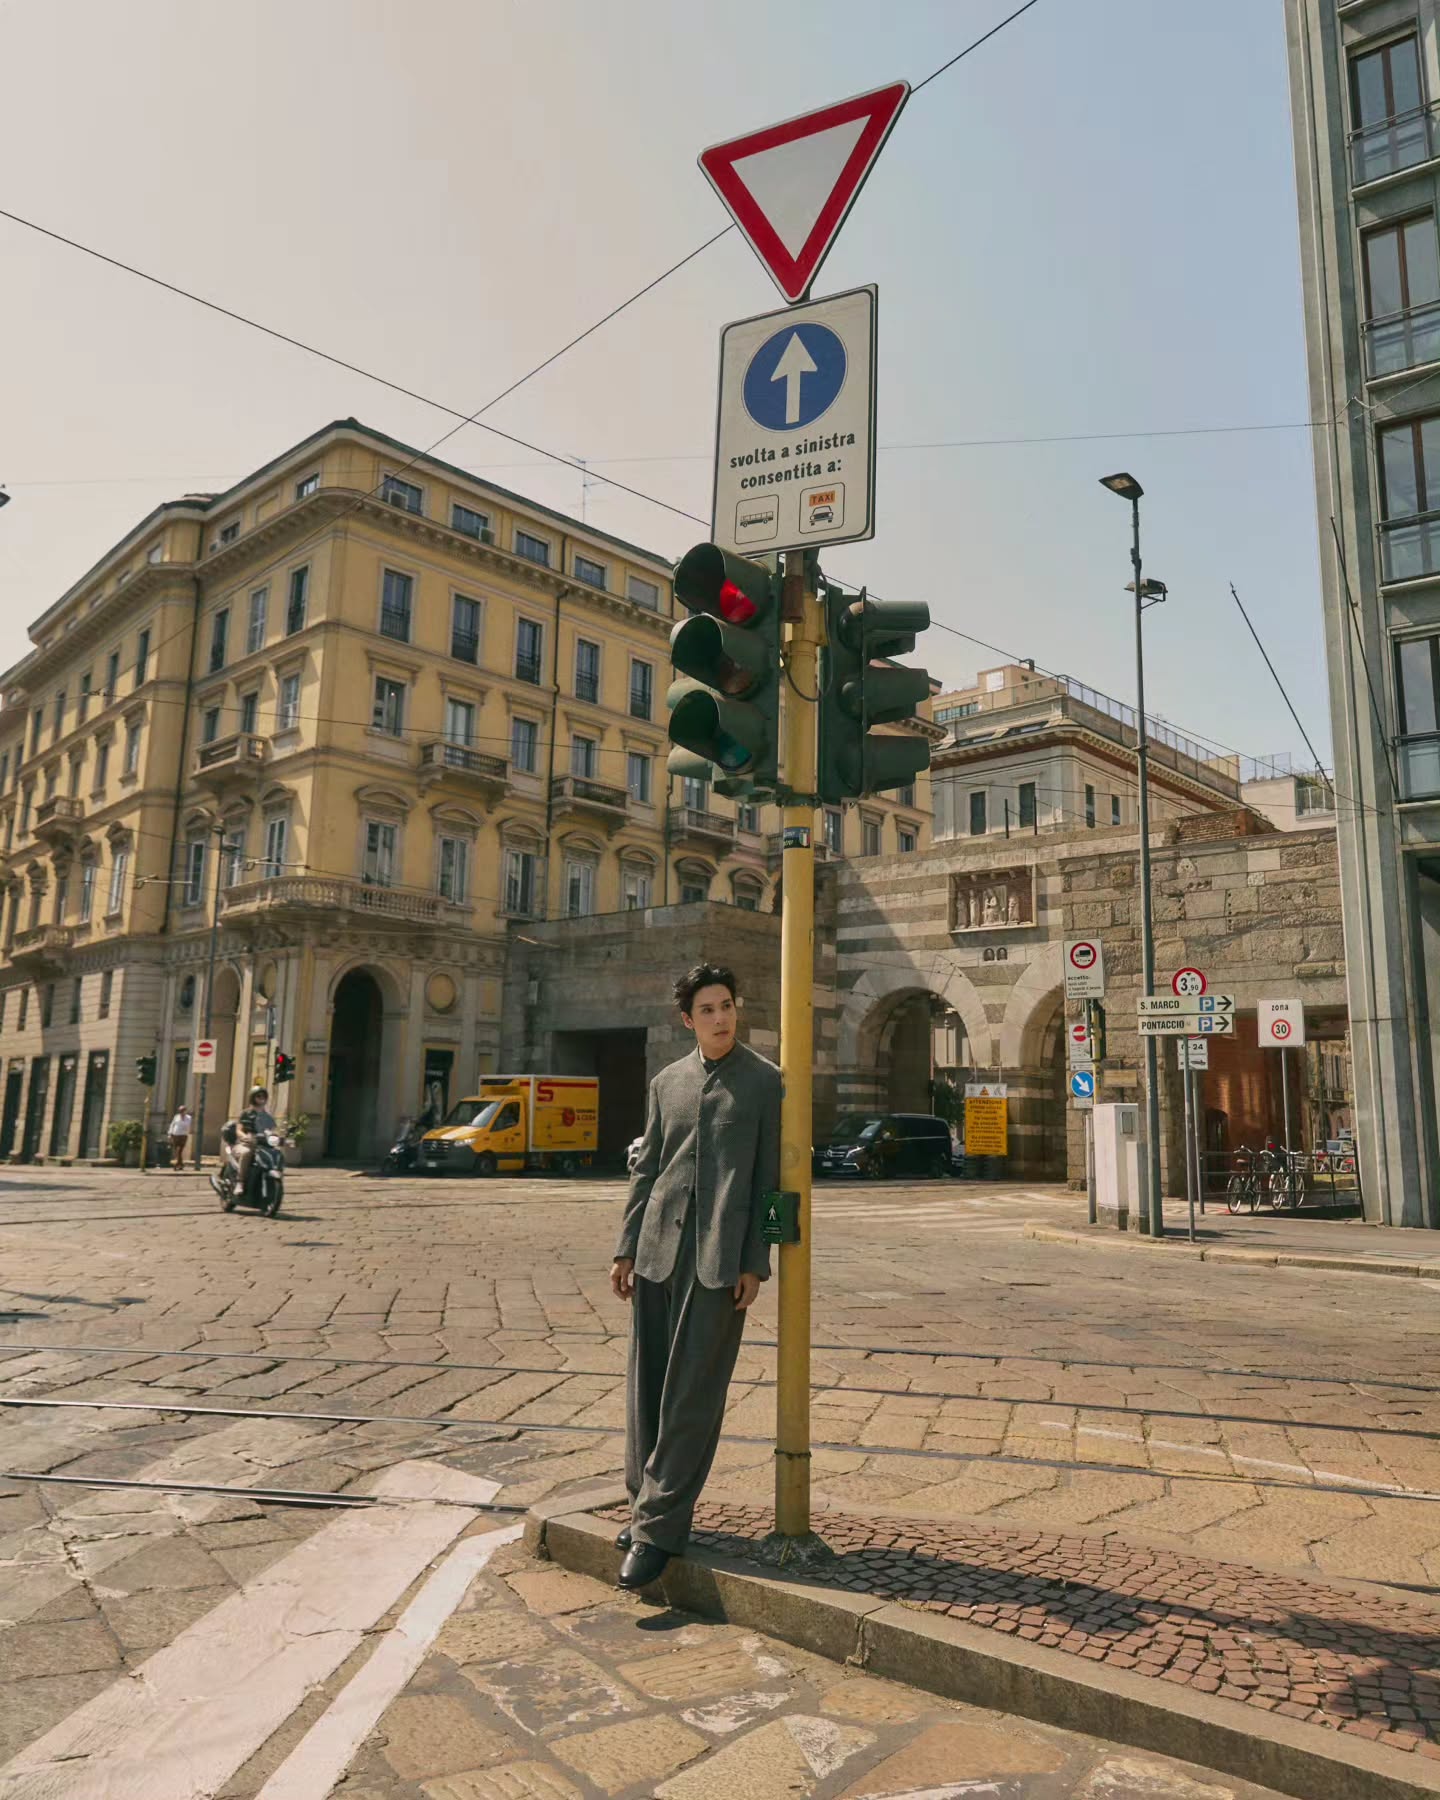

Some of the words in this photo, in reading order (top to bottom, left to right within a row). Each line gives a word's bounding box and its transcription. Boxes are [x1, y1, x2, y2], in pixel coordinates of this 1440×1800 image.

[730, 448, 776, 468] svolta
[781, 446, 790, 459] a
[795, 433, 856, 455] sinistra
[740, 462, 822, 489] consentita
[827, 458, 842, 473] a:
[812, 492, 835, 505] TAXI
[1140, 1001, 1148, 1010] S.
[1150, 1000, 1180, 1010] MARCO
[1141, 1020, 1185, 1030] PONTACCIO
[1275, 1024, 1287, 1034] 30
